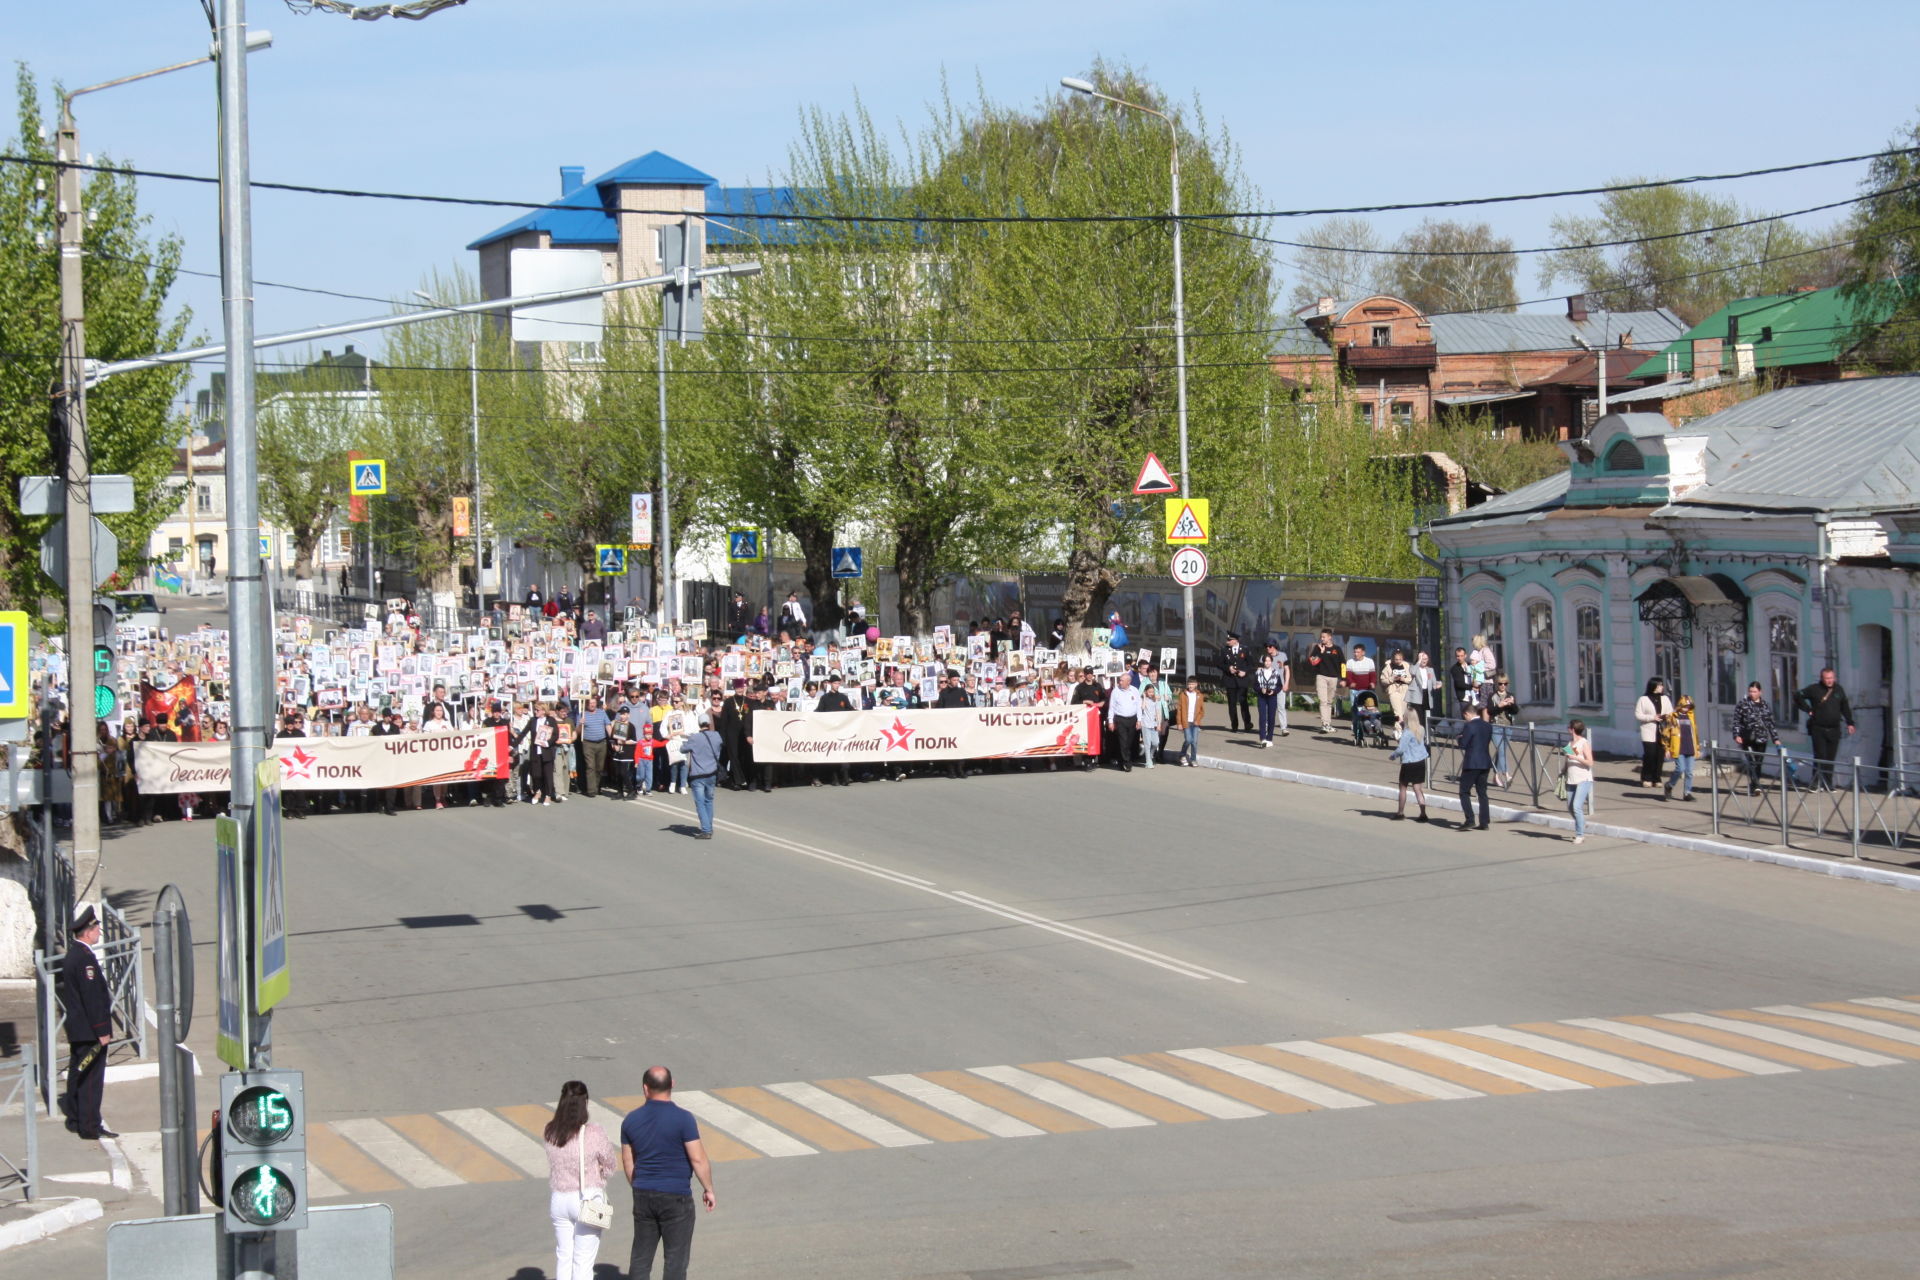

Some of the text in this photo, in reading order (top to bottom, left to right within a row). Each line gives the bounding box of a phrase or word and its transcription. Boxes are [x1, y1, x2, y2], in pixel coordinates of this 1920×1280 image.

[1181, 560, 1198, 574] 20
[978, 711, 1080, 727] ЧИСТОПОЛЬ
[384, 734, 488, 755] ЧИСТОПОЛЬ
[782, 719, 958, 757] бессмертный ПОЛК
[169, 748, 363, 785] бессмер ПОЛК
[257, 1091, 290, 1130] 15
